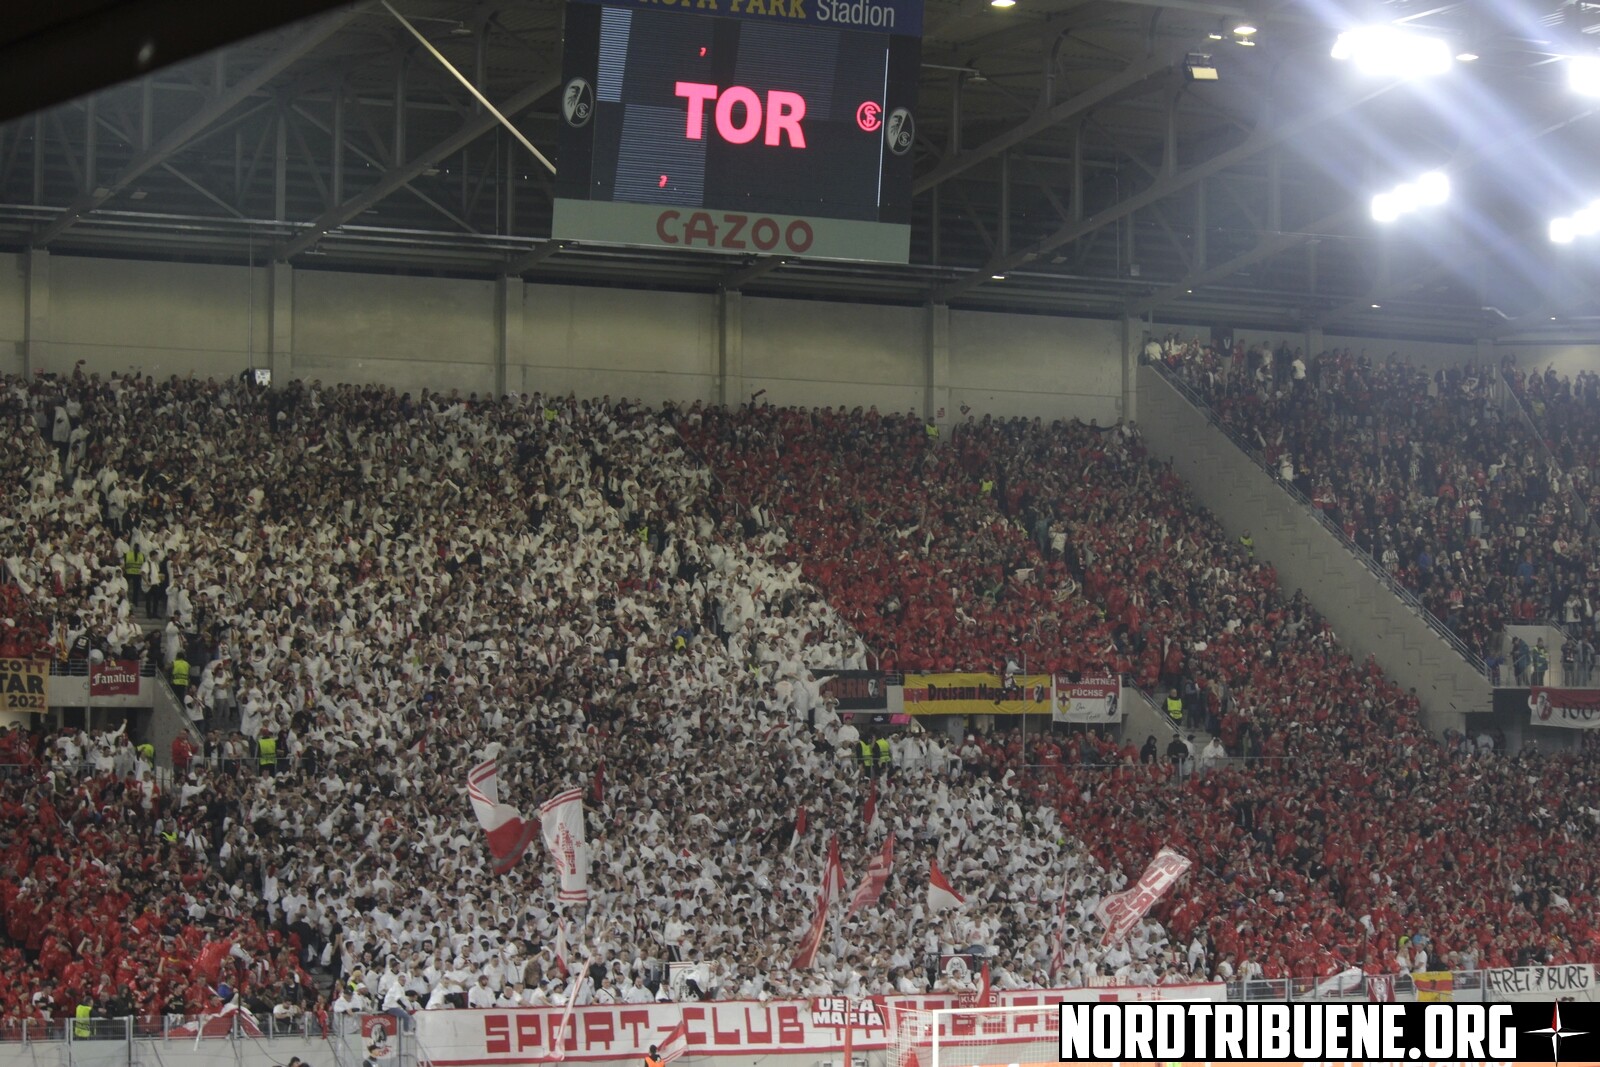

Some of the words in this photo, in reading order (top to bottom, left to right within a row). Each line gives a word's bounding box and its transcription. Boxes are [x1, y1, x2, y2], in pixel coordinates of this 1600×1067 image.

[729, 0, 807, 19] PARK
[816, 0, 895, 28] Stadion
[674, 81, 807, 149] TOR
[656, 209, 814, 252] CAZOO
[92, 672, 137, 686] Fanatics
[928, 683, 976, 701] Dreisam
[1072, 687, 1104, 697] FÜCHSE
[8, 694, 45, 709] 2022
[1547, 966, 1589, 991] BURG
[813, 1011, 885, 1026] MAFIA
